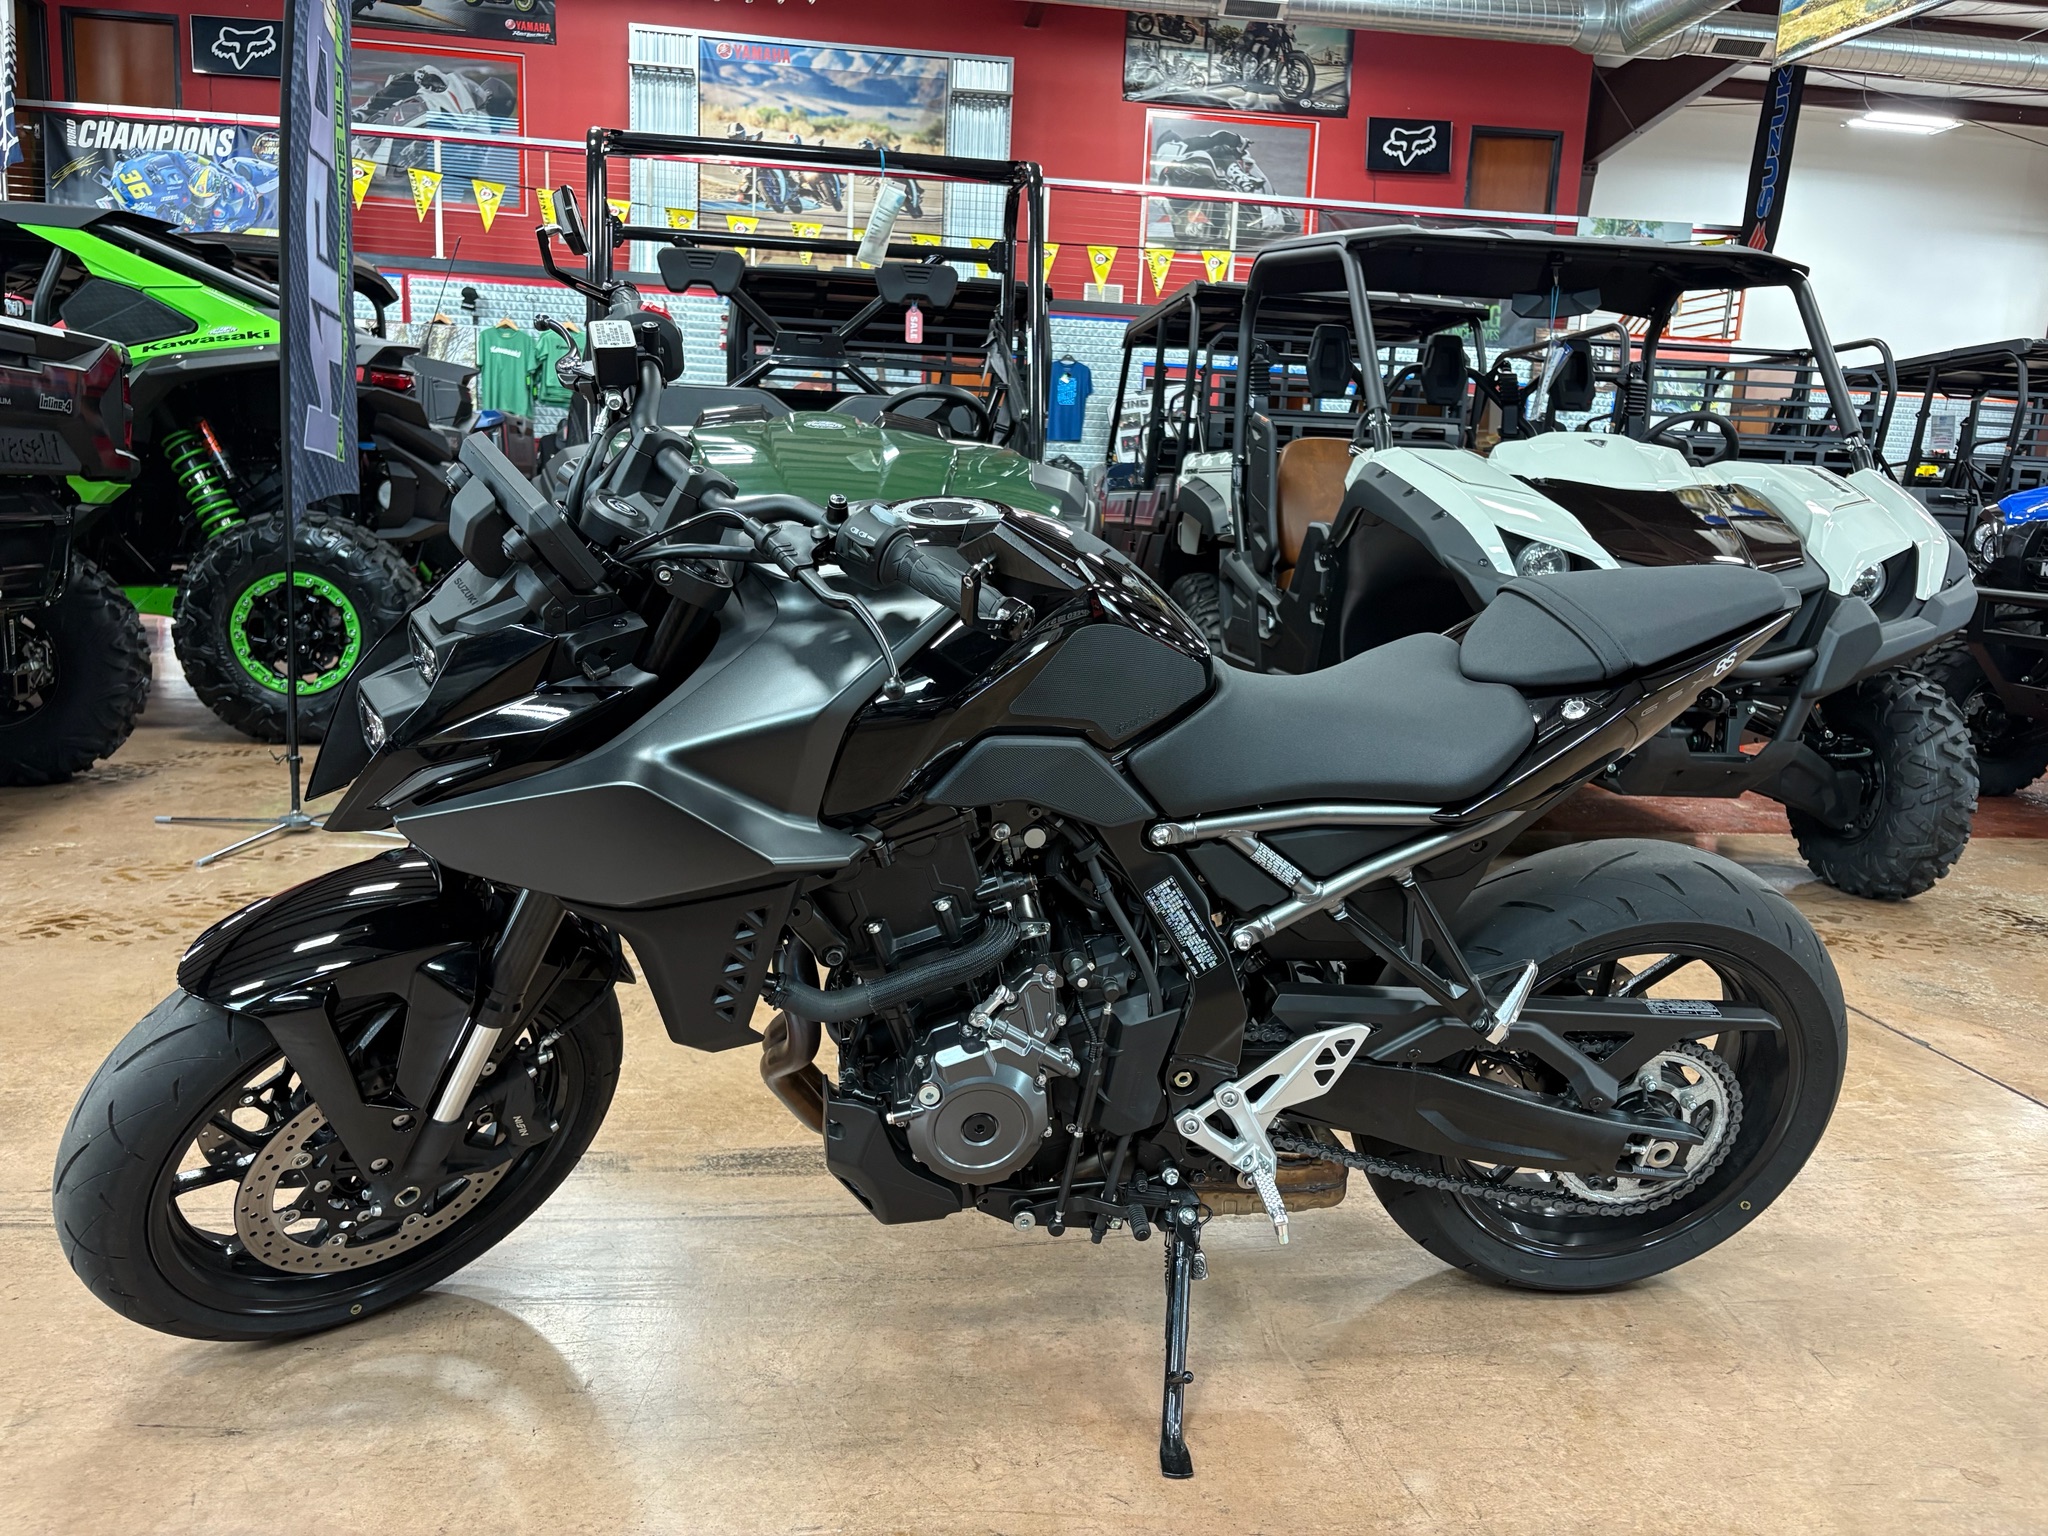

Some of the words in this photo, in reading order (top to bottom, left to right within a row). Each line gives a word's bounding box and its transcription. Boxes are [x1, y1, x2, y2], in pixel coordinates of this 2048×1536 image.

[515, 20, 551, 33] YAMAHA
[733, 44, 791, 64] YAMAHA
[66, 118, 77, 147] WORLD
[77, 119, 235, 158] CHAMPIONS
[1756, 65, 1794, 219] SUZUK
[119, 169, 153, 199] 36
[141, 329, 271, 353] Kawasaki
[909, 315, 919, 340] SALE
[40, 393, 73, 414] Inline-4
[453, 577, 479, 606] SUZUKI
